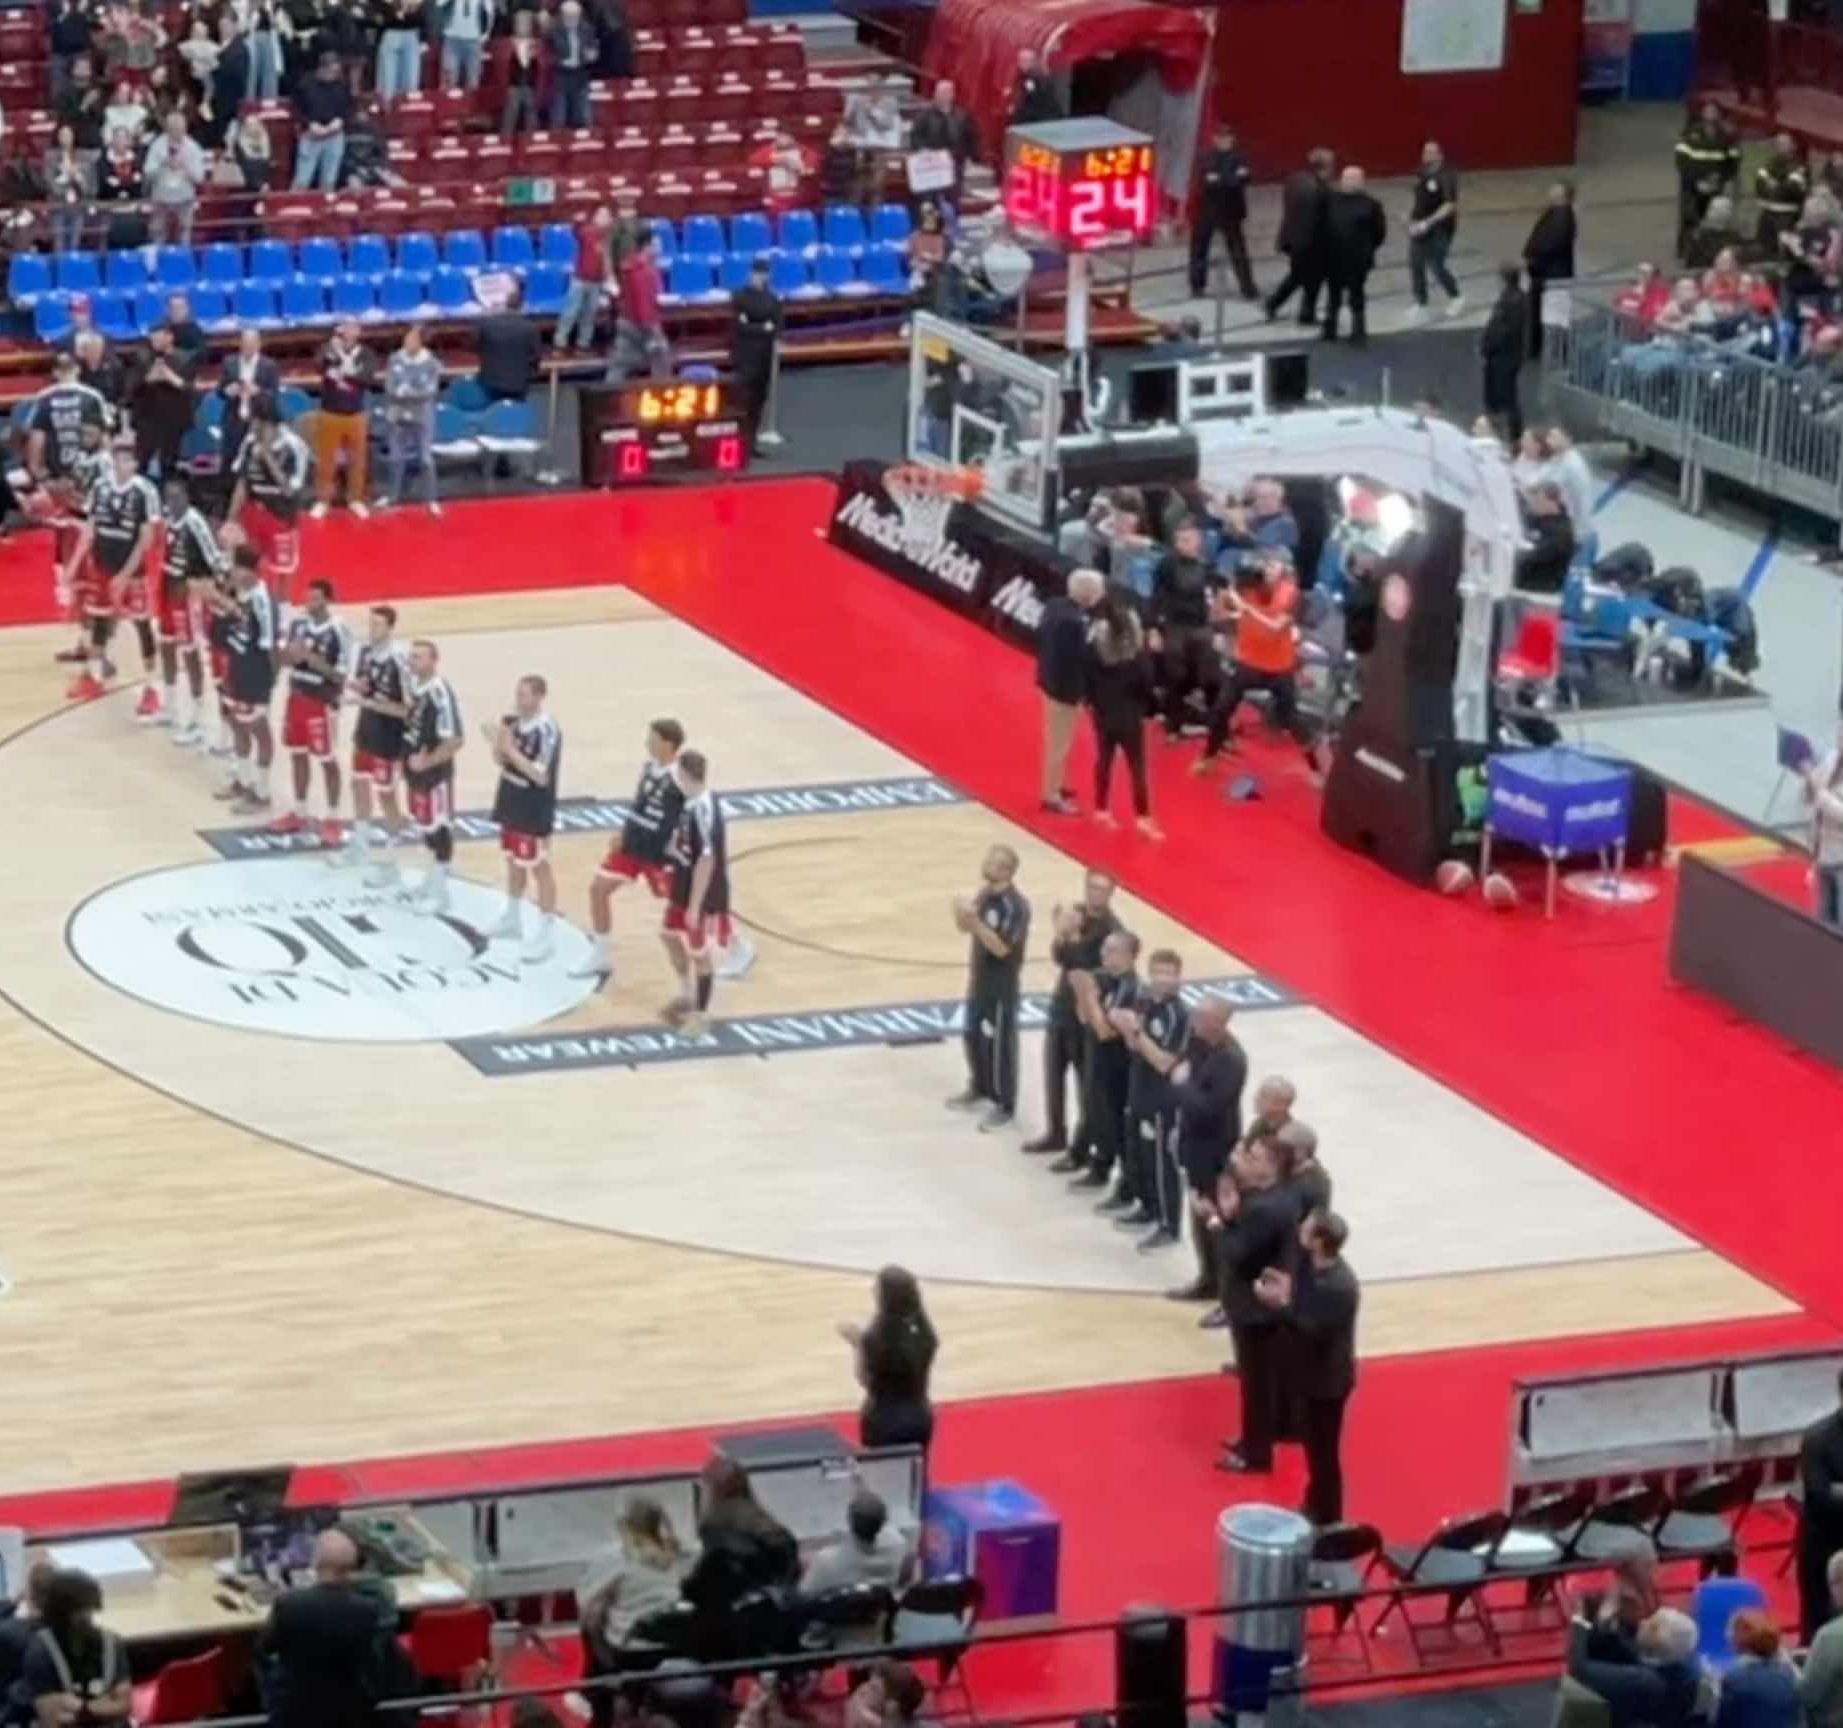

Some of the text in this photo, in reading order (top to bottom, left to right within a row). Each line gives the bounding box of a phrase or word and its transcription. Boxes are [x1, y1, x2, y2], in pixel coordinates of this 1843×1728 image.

[1085, 145, 1151, 177] 6:21
[1069, 174, 1148, 235] 24
[639, 384, 720, 421] 6:21
[623, 443, 643, 474] 0
[717, 438, 740, 469] 0
[729, 1007, 947, 1046] ARMANI
